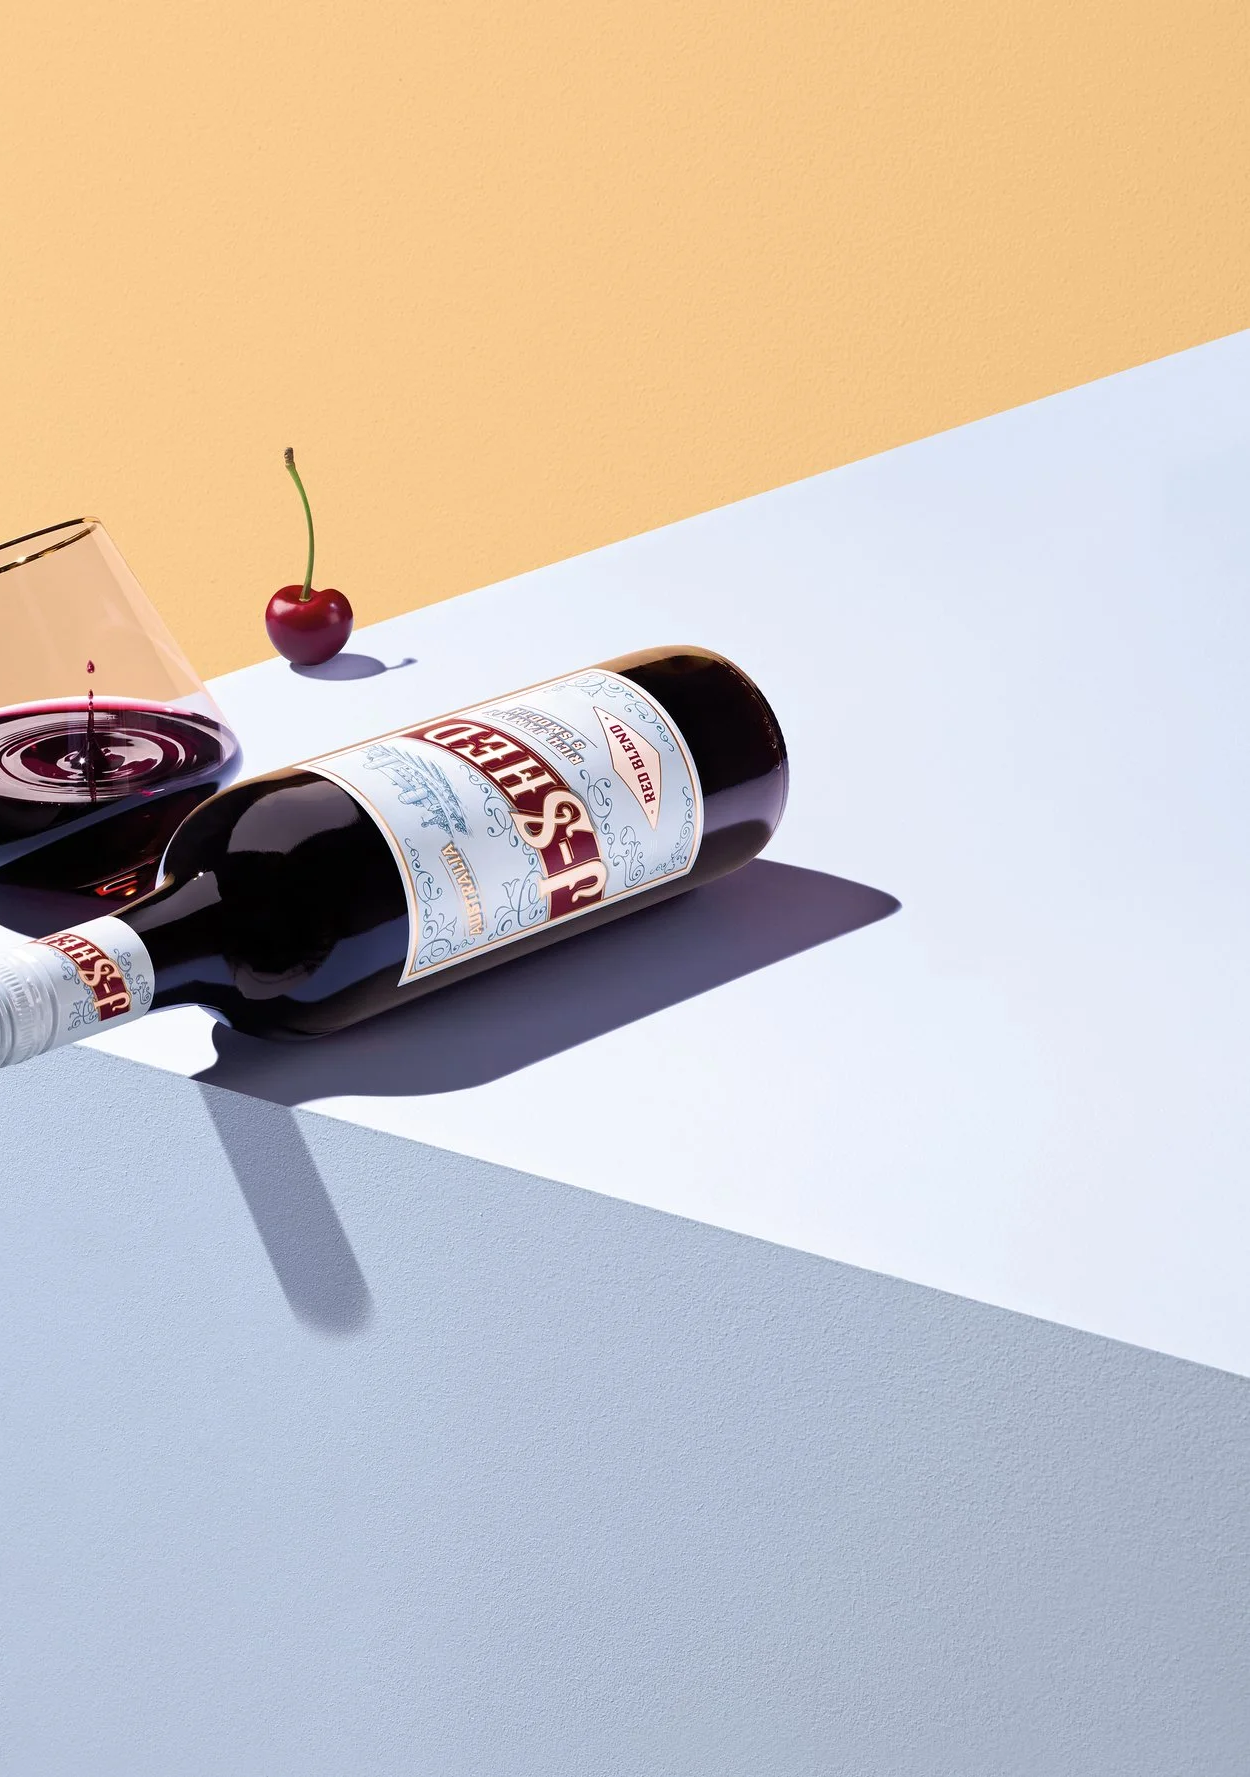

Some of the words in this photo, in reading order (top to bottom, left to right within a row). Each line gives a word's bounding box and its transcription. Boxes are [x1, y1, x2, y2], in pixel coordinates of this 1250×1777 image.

[482, 709, 549, 735] JAMMY
[507, 706, 574, 740] SMOOTH
[571, 740, 587, 751] &
[609, 724, 646, 770] BLEND
[637, 772, 656, 804] RED
[423, 713, 607, 903] J-SHED
[440, 841, 484, 935] AUSTRALIA
